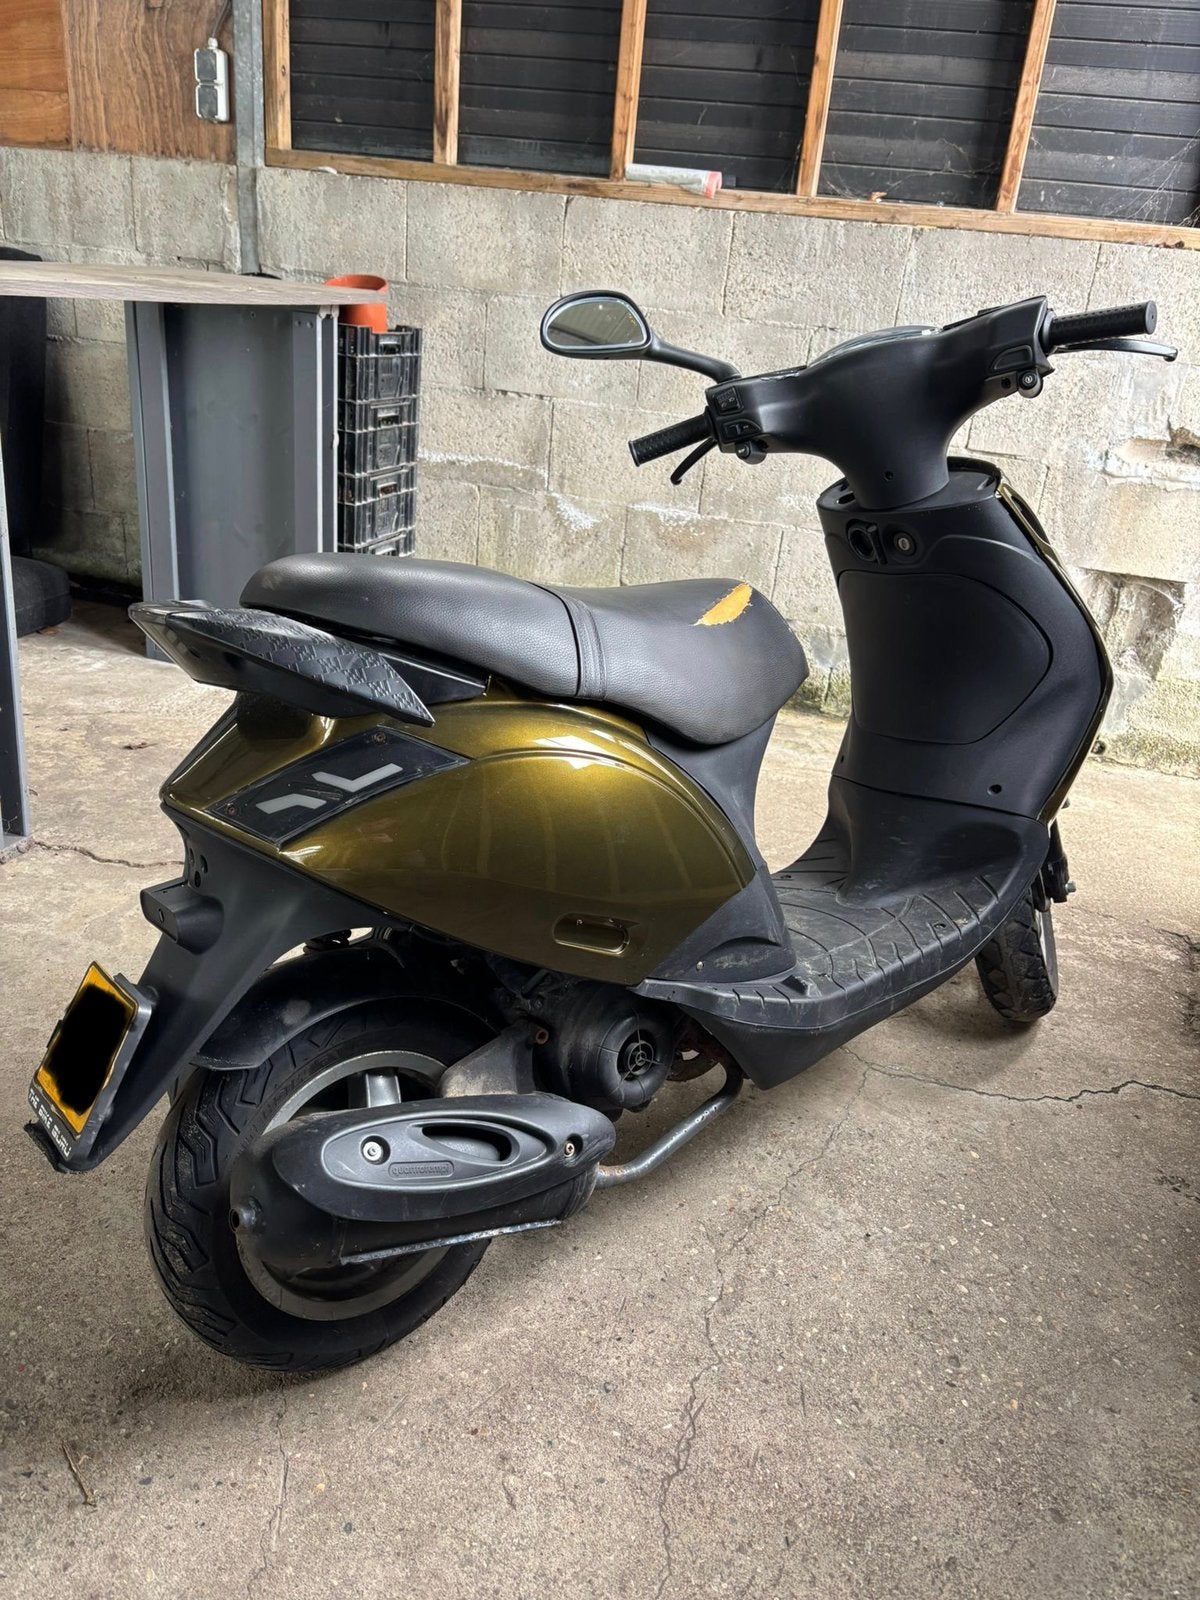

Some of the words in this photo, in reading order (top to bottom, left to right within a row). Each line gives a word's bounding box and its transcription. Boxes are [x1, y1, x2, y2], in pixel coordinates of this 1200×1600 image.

[28, 1087, 40, 1109] THE
[38, 1104, 53, 1129] BIKE
[51, 1124, 72, 1158] GURU
